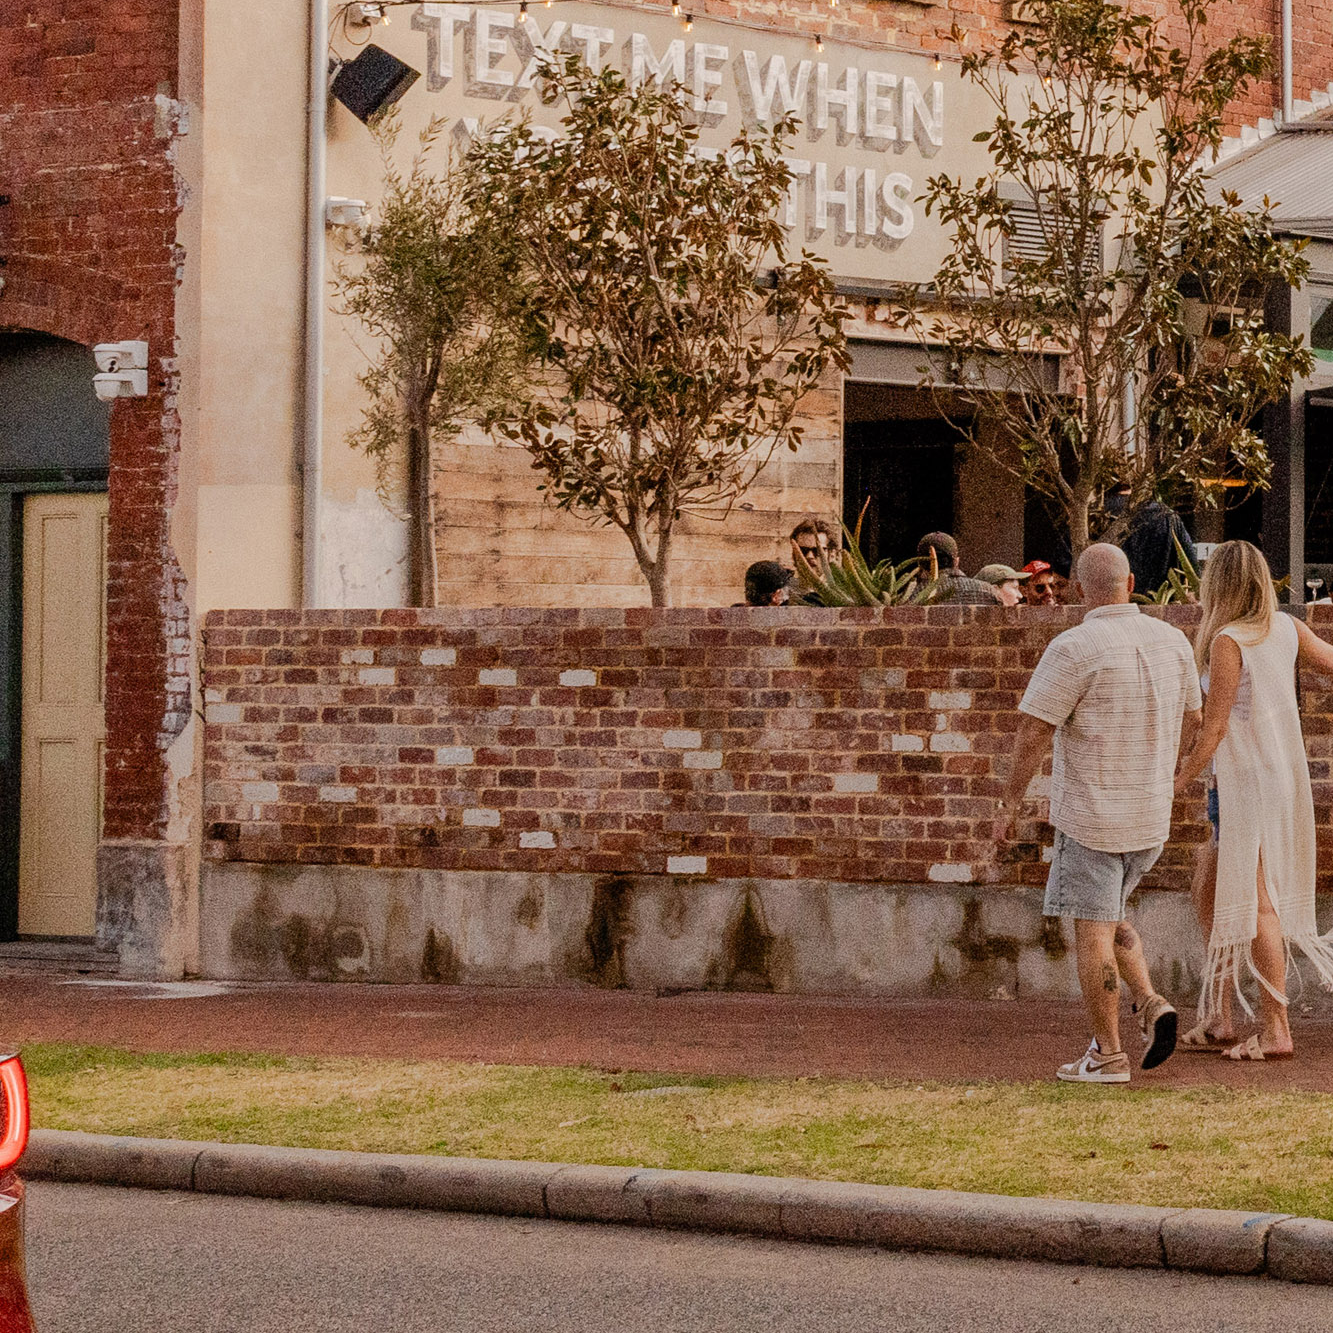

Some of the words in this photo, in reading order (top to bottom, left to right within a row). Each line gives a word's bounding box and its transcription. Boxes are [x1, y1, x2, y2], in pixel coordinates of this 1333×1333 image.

[421, 2, 615, 94] TEXT
[630, 32, 729, 115] ME
[742, 49, 944, 147] WHEN
[776, 155, 914, 240] THIS
